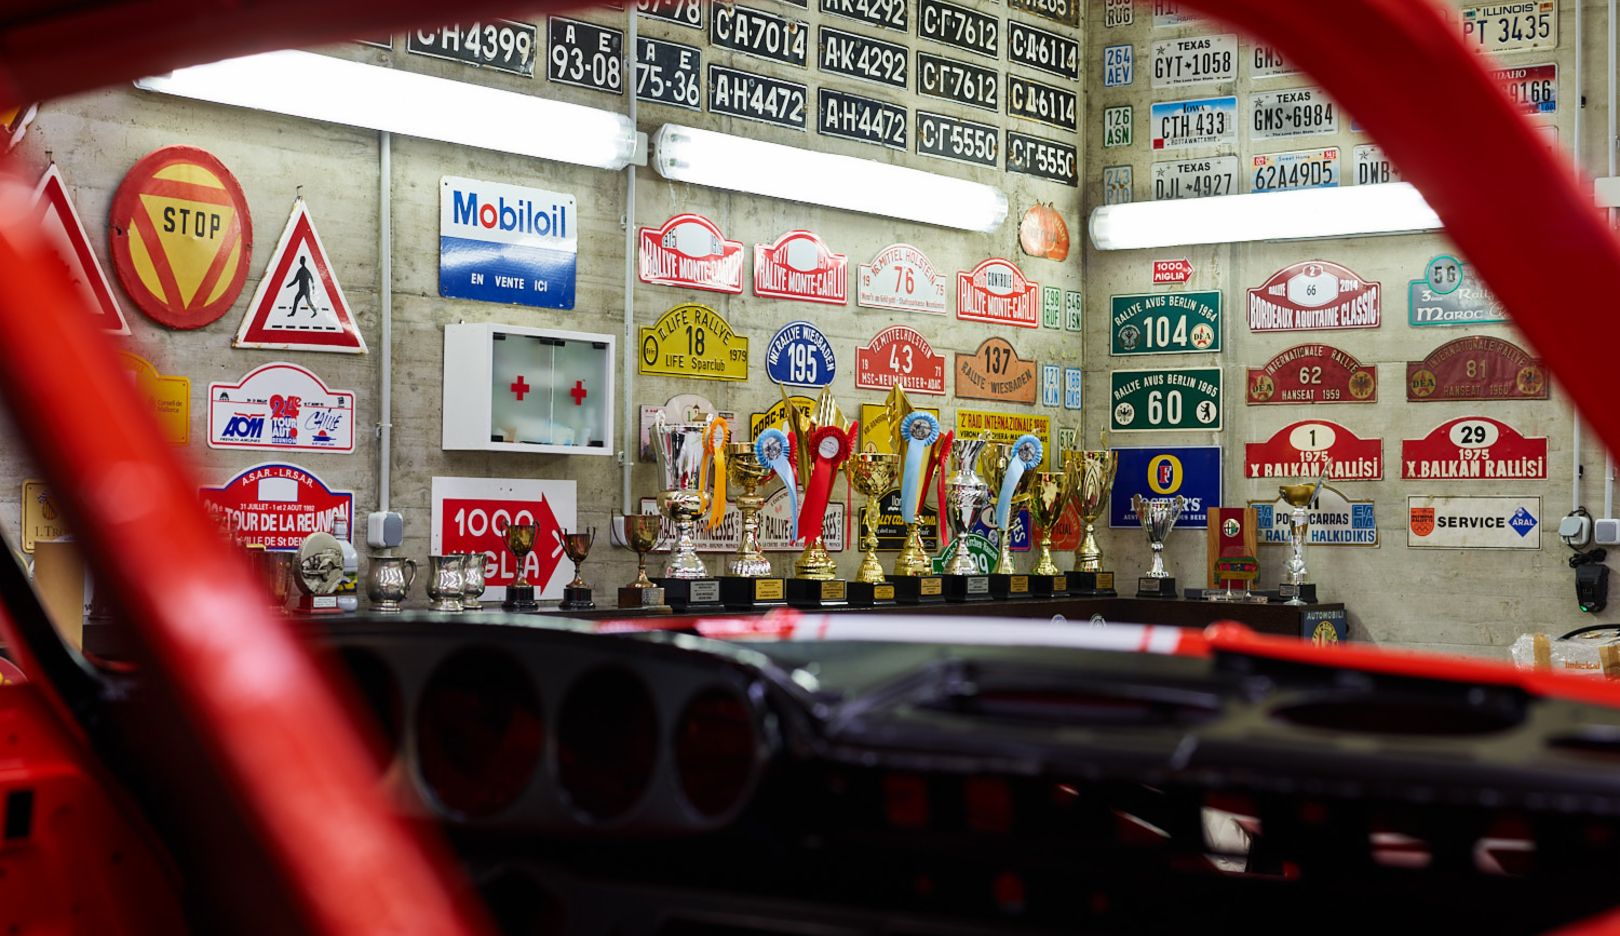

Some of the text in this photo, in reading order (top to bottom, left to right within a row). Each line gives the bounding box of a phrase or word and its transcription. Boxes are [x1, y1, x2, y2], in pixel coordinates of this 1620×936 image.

[1482, 4, 1533, 17] ILLINOIS
[1498, 14, 1550, 43] 3435
[1178, 40, 1211, 52] TEXAS
[552, 44, 621, 89] 93-08
[1108, 49, 1130, 66] 264
[636, 63, 700, 106] 75-36
[1108, 66, 1130, 85] AEV
[1277, 91, 1311, 104] TEXAS
[1108, 108, 1130, 126] 126
[1196, 112, 1225, 135] 433
[1293, 103, 1333, 128] 6984
[1107, 127, 1130, 146] ASN
[1178, 163, 1211, 173] TEXAS
[1193, 173, 1232, 198] 4927
[163, 206, 220, 240] STOP
[453, 190, 566, 238] Mobiloil
[1155, 271, 1185, 281] MIGLIA
[1156, 262, 1183, 272] 1000
[1309, 265, 1315, 277] 2
[471, 273, 548, 293] EN VENTE ICI
[895, 265, 915, 295] 76
[1340, 279, 1359, 291] 2014
[1306, 285, 1316, 296] 66
[1114, 295, 1218, 326] RALLYE AVUS BERLIN 1964
[1250, 292, 1294, 329] BORDEAUX
[1341, 289, 1378, 326] CLASSIC
[666, 310, 732, 346] LIFE RALLYE
[1143, 315, 1188, 348] 104
[686, 325, 705, 356] 18
[665, 354, 685, 369] LIFE
[729, 349, 747, 363] 1979
[787, 342, 817, 383] 195
[889, 344, 914, 374] 43
[985, 346, 1011, 375] 137
[1299, 366, 1322, 386] 62
[1466, 360, 1487, 379] 81
[1114, 374, 1219, 401] RALLYE AVUS BERLIN 1965
[1282, 388, 1341, 401] HANSEAT 1959
[1147, 389, 1183, 425] 60
[222, 416, 265, 439] AOM
[272, 417, 298, 429] TOUR
[1309, 429, 1316, 447] 1
[1460, 425, 1486, 444] 29
[1300, 450, 1329, 463] 1975
[1458, 448, 1490, 461] 1975
[1250, 463, 1260, 477] X
[247, 503, 268, 511] JUILLET
[261, 512, 277, 531] DE
[279, 512, 297, 532] LA
[454, 507, 534, 538] 1000
[1309, 512, 1349, 525] CARRAS
[1437, 516, 1505, 528] SERVICE
[1512, 519, 1534, 527] ARAL
[264, 536, 287, 546] DE St
[1311, 529, 1375, 542] HALKIDIKIS
